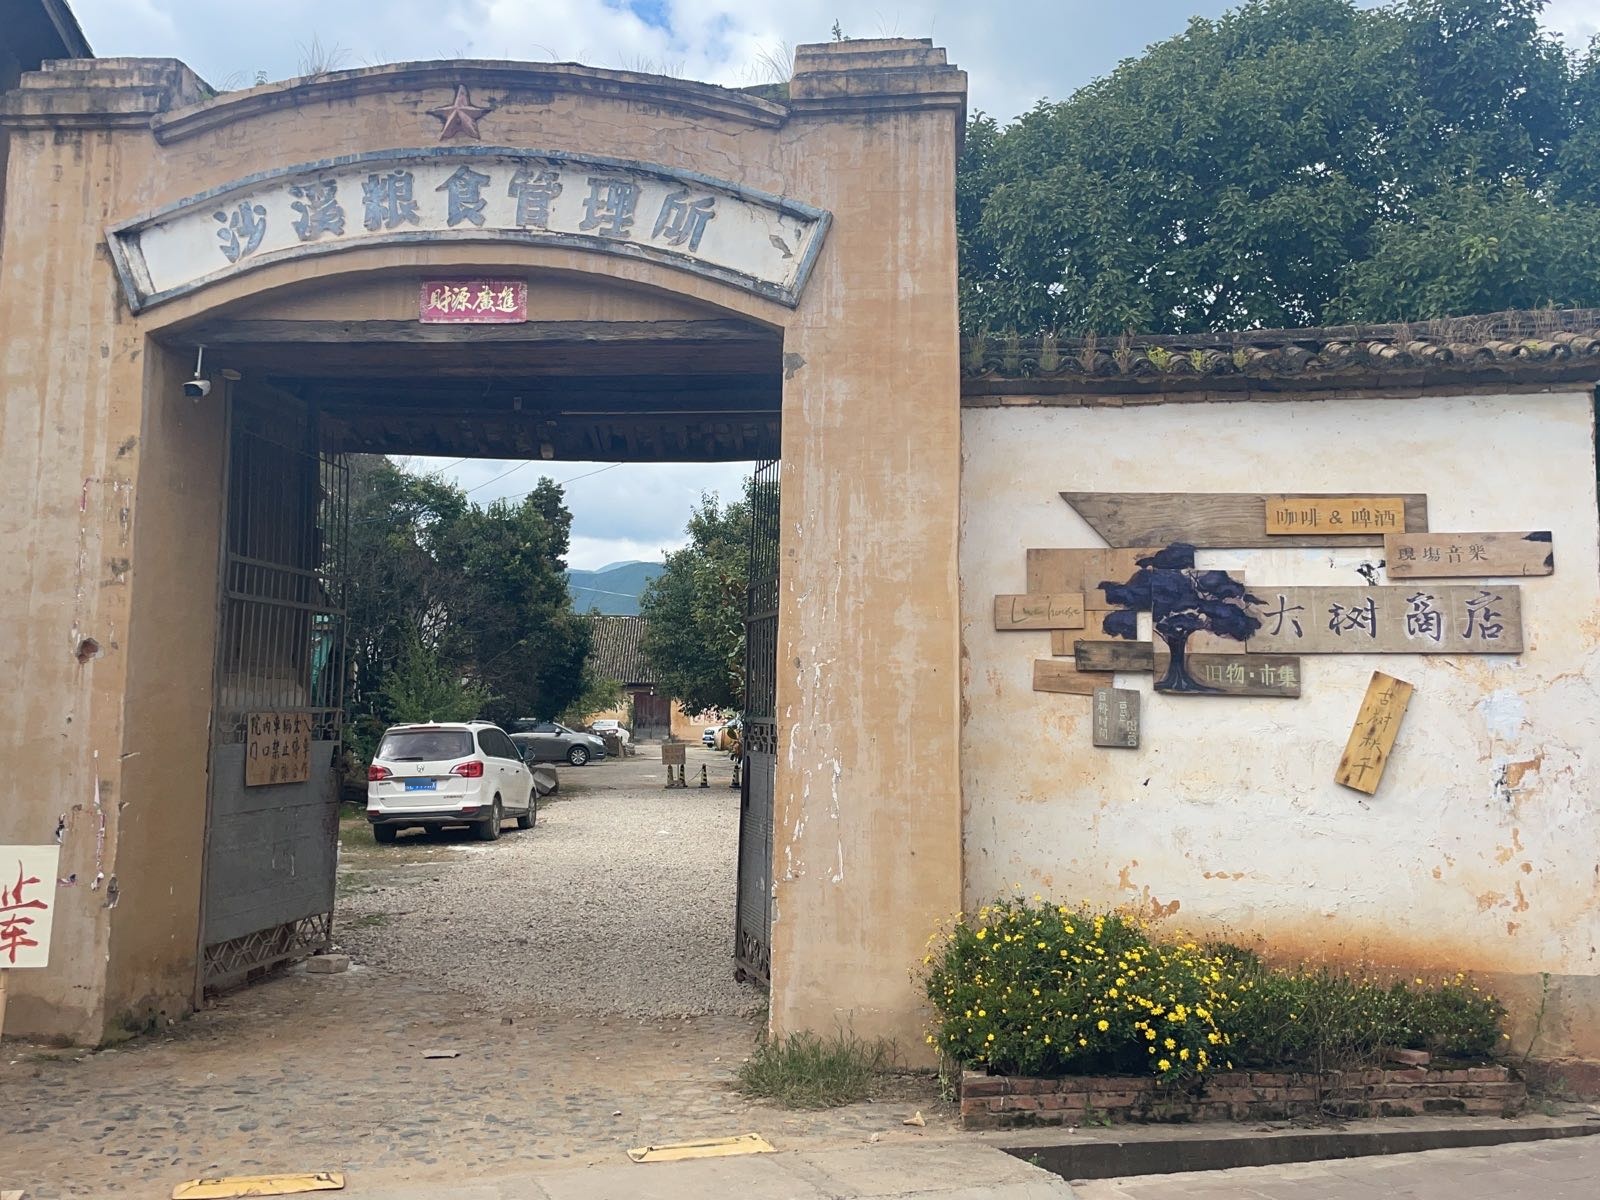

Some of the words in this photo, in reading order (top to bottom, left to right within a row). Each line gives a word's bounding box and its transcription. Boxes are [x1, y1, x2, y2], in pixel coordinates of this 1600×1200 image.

[212, 164, 716, 264] 沙溪粮食管理所
[427, 285, 519, 313] 財源廣進
[1275, 507, 1323, 528] 咖啡
[1329, 509, 1343, 525] &
[1351, 507, 1396, 528] 啤酒
[1263, 590, 1505, 643] 大树商店
[1351, 687, 1395, 784] 古树秋千
